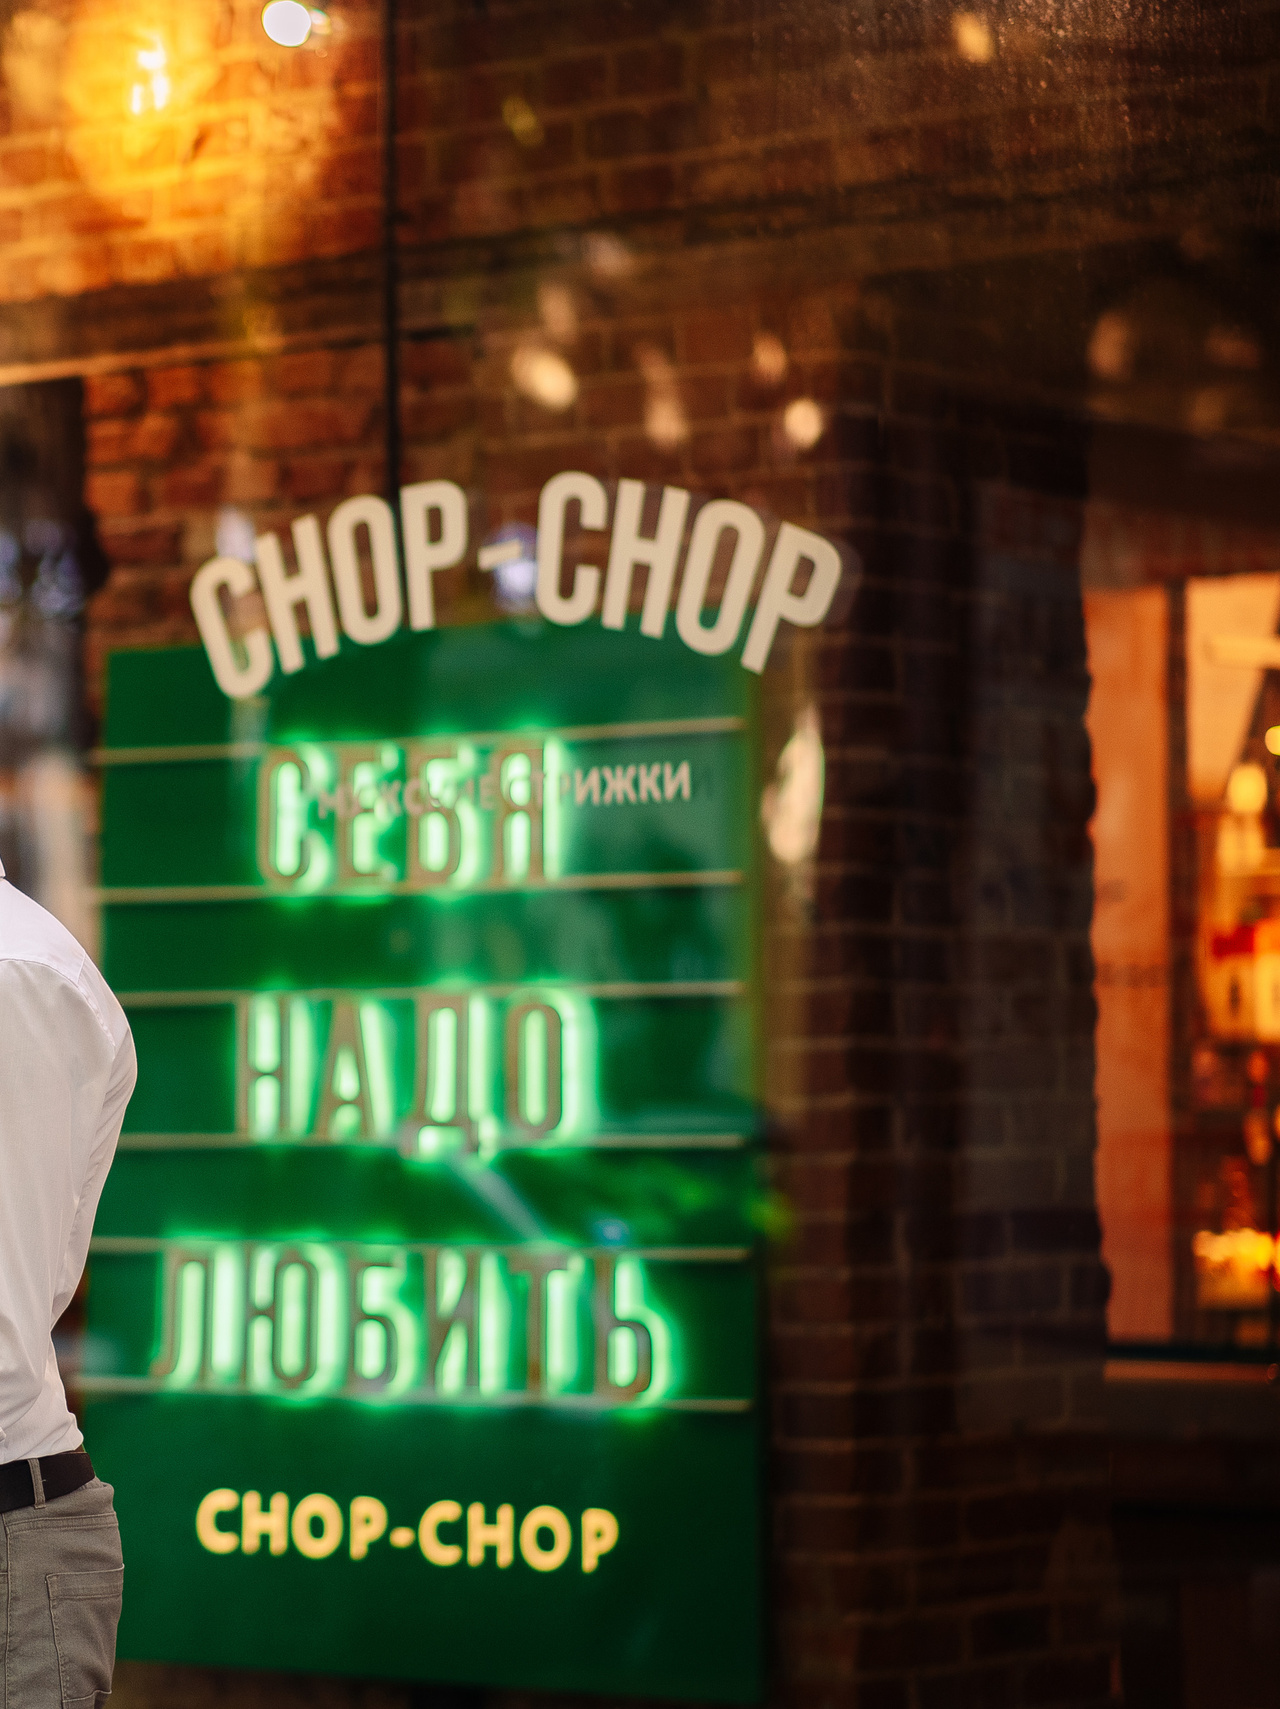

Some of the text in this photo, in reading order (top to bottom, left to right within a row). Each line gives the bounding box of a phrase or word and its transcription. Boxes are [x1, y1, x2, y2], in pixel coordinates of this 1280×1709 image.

[189, 470, 842, 699] CHOP-CHOP
[258, 738, 562, 893] СЕБЯ
[236, 988, 592, 1160] НАДО
[152, 1245, 676, 1406] ЛЮБИТЬ
[195, 1487, 620, 1574] CHOP-CHOP
